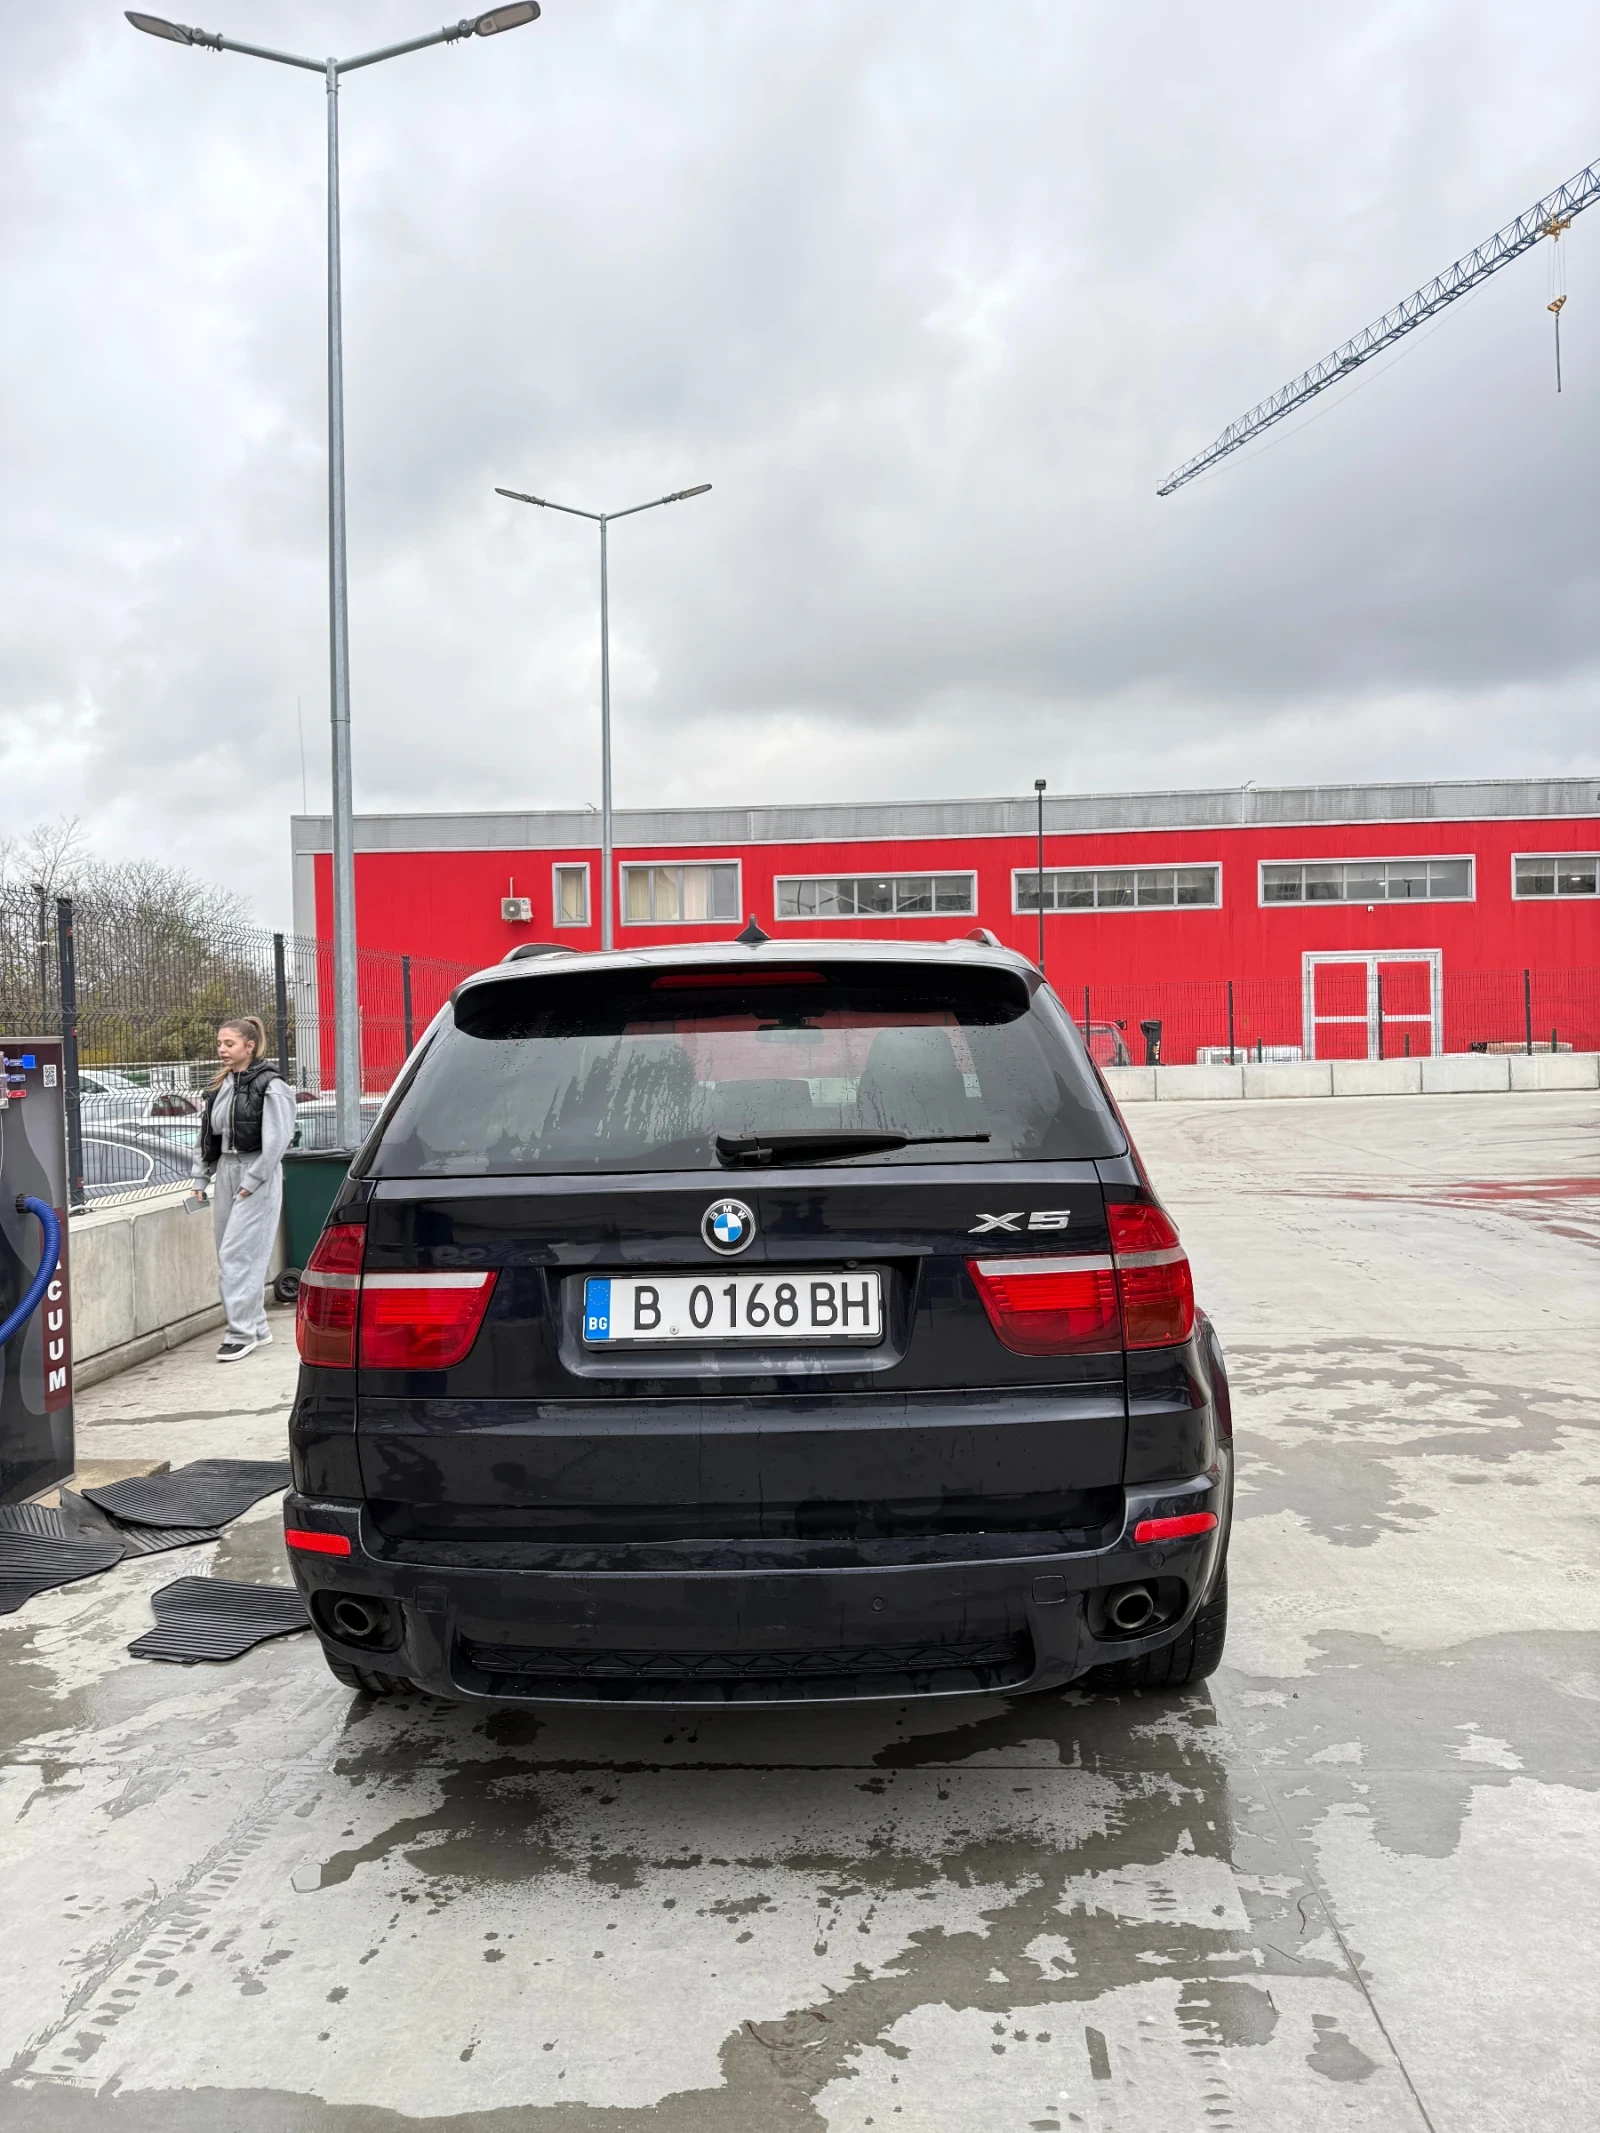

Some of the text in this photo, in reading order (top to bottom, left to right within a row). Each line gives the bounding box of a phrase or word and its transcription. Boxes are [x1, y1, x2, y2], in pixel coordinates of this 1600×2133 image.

[709, 1205, 748, 1221] BMW
[967, 1210, 1071, 1233] X5
[634, 1281, 870, 1330] B 0168 BH
[47, 1259, 66, 1393] CUUM
[588, 1316, 608, 1331] BG
